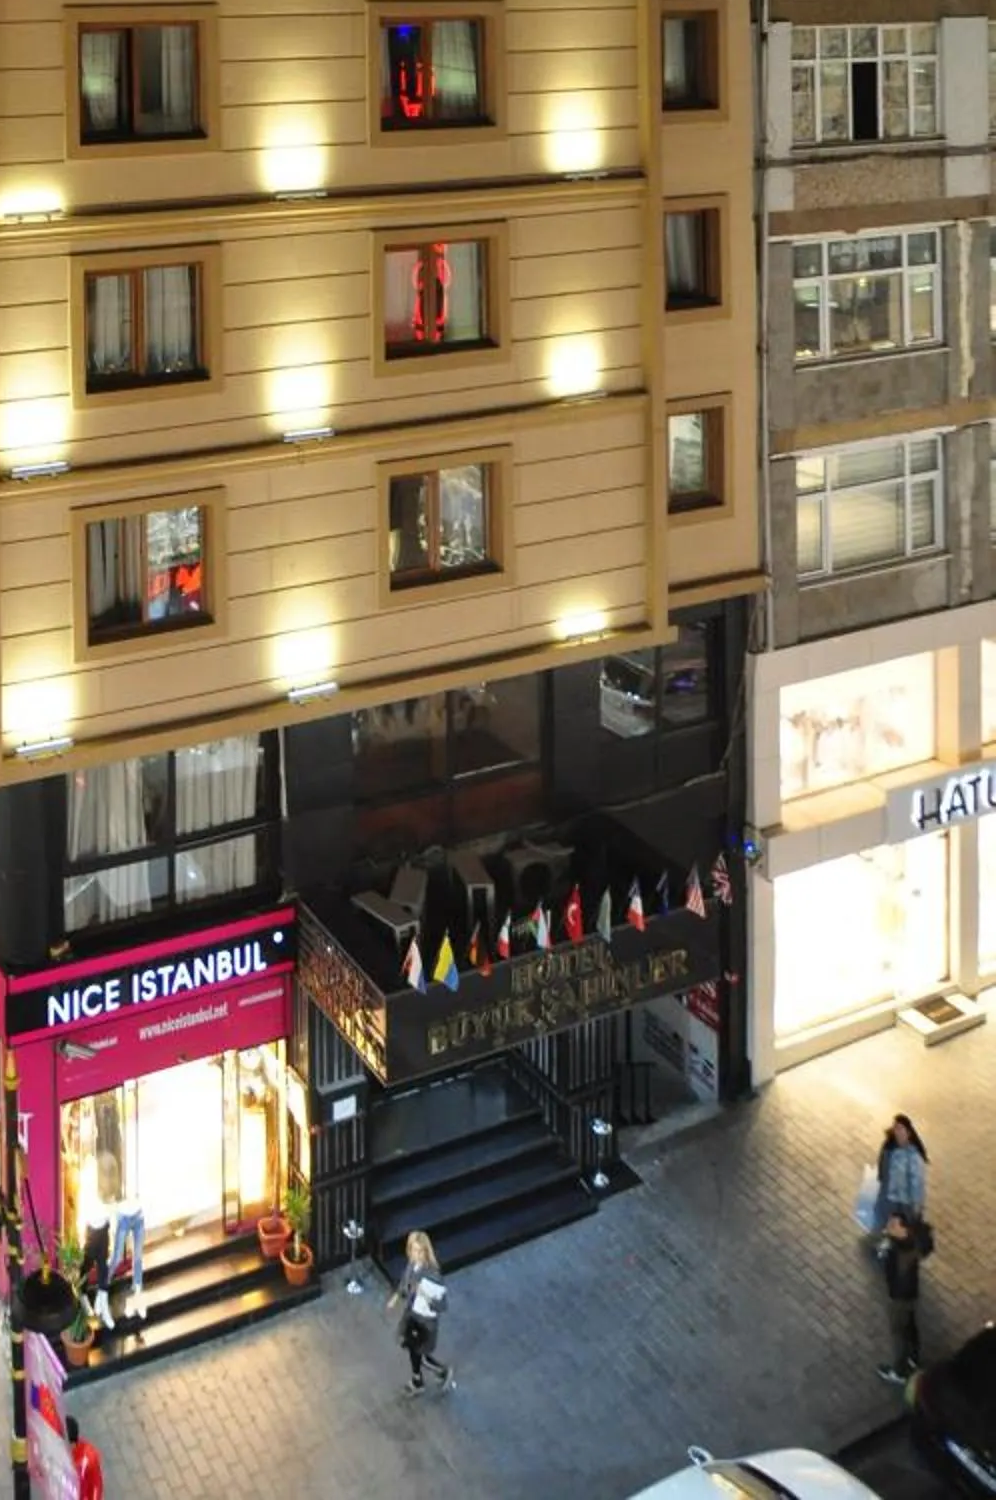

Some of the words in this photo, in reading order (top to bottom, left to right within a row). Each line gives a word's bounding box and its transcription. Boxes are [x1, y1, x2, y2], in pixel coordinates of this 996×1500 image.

[47, 979, 121, 1026] NICE
[132, 942, 268, 1003] ISTANBUL
[511, 939, 612, 993] HOTEL
